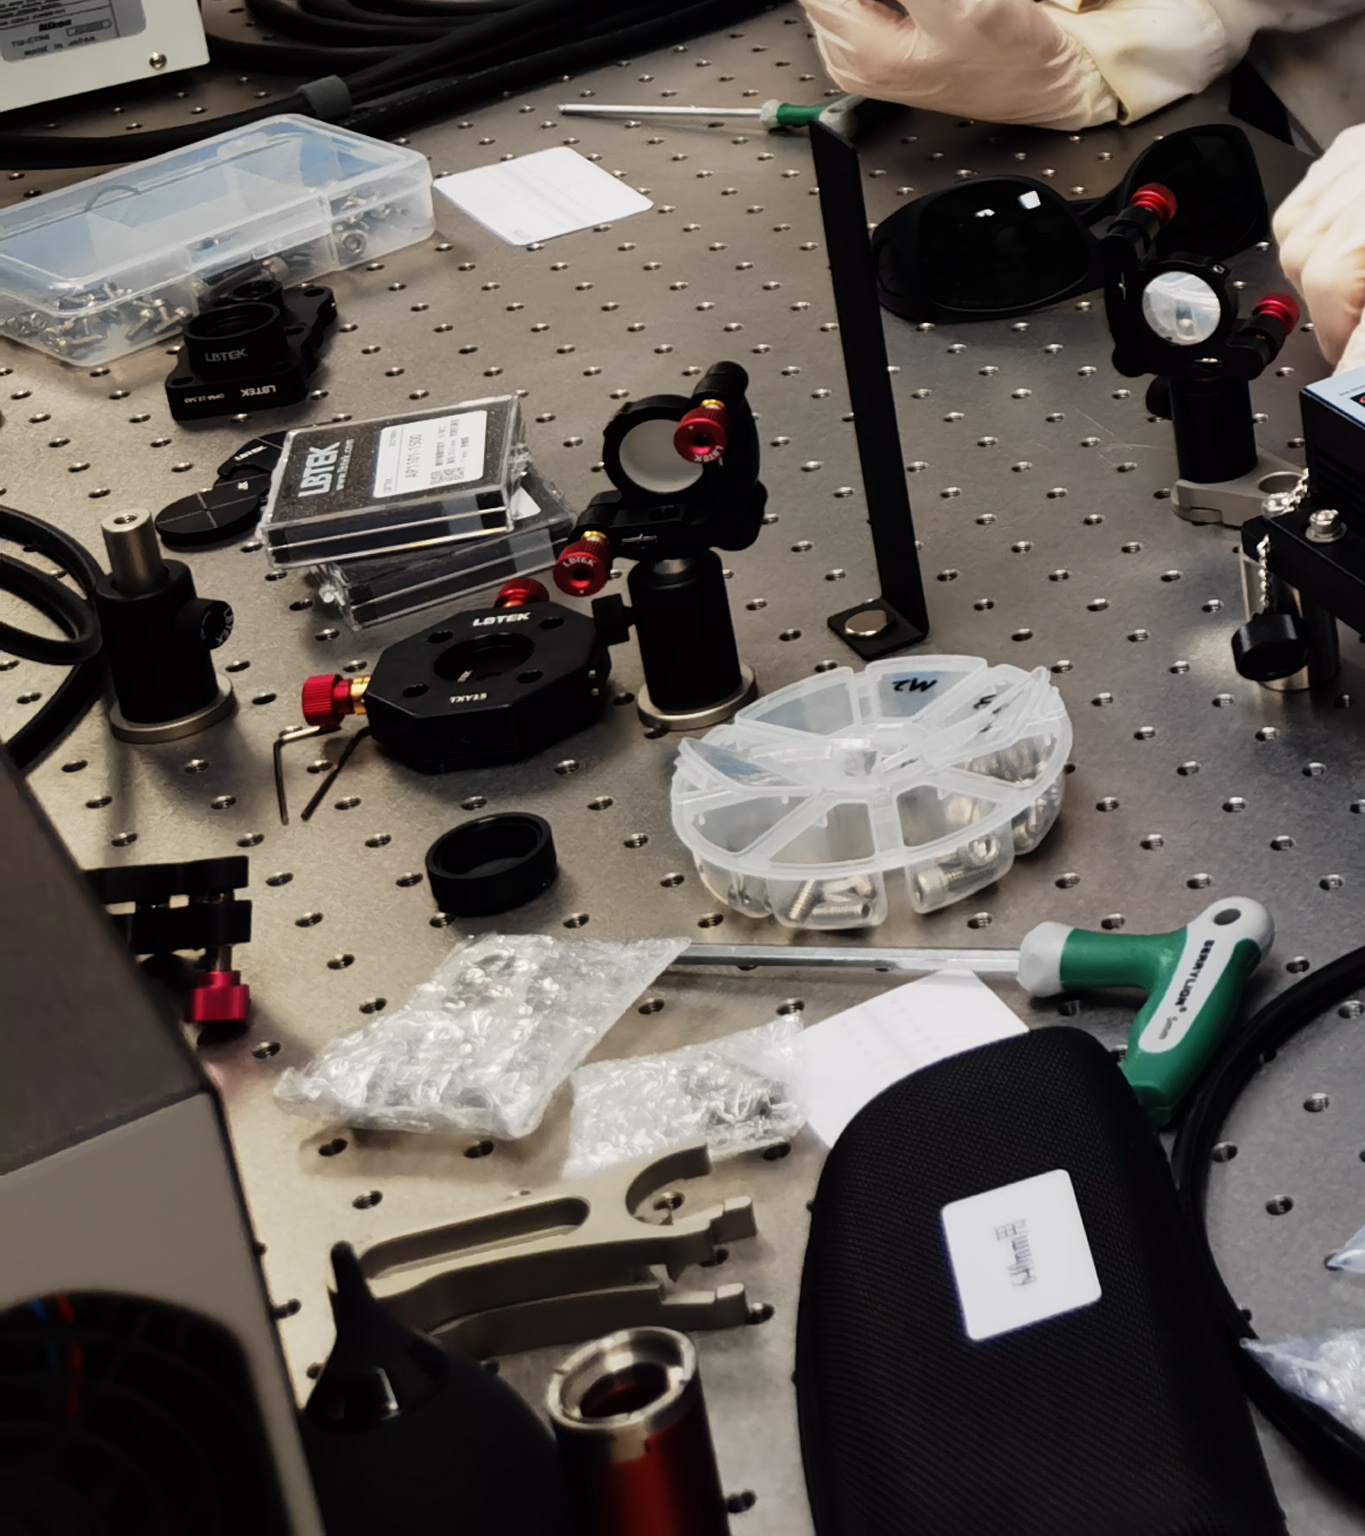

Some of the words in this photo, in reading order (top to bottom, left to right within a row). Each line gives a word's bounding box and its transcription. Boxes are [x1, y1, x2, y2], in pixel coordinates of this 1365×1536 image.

[204, 348, 249, 362] LBTEK
[240, 384, 276, 398] LBTEK
[693, 445, 724, 462] LBTEK
[298, 441, 341, 498] LBTEK
[215, 607, 234, 646] LBTEK
[472, 612, 531, 627] LBTEK
[892, 677, 938, 693] M2
